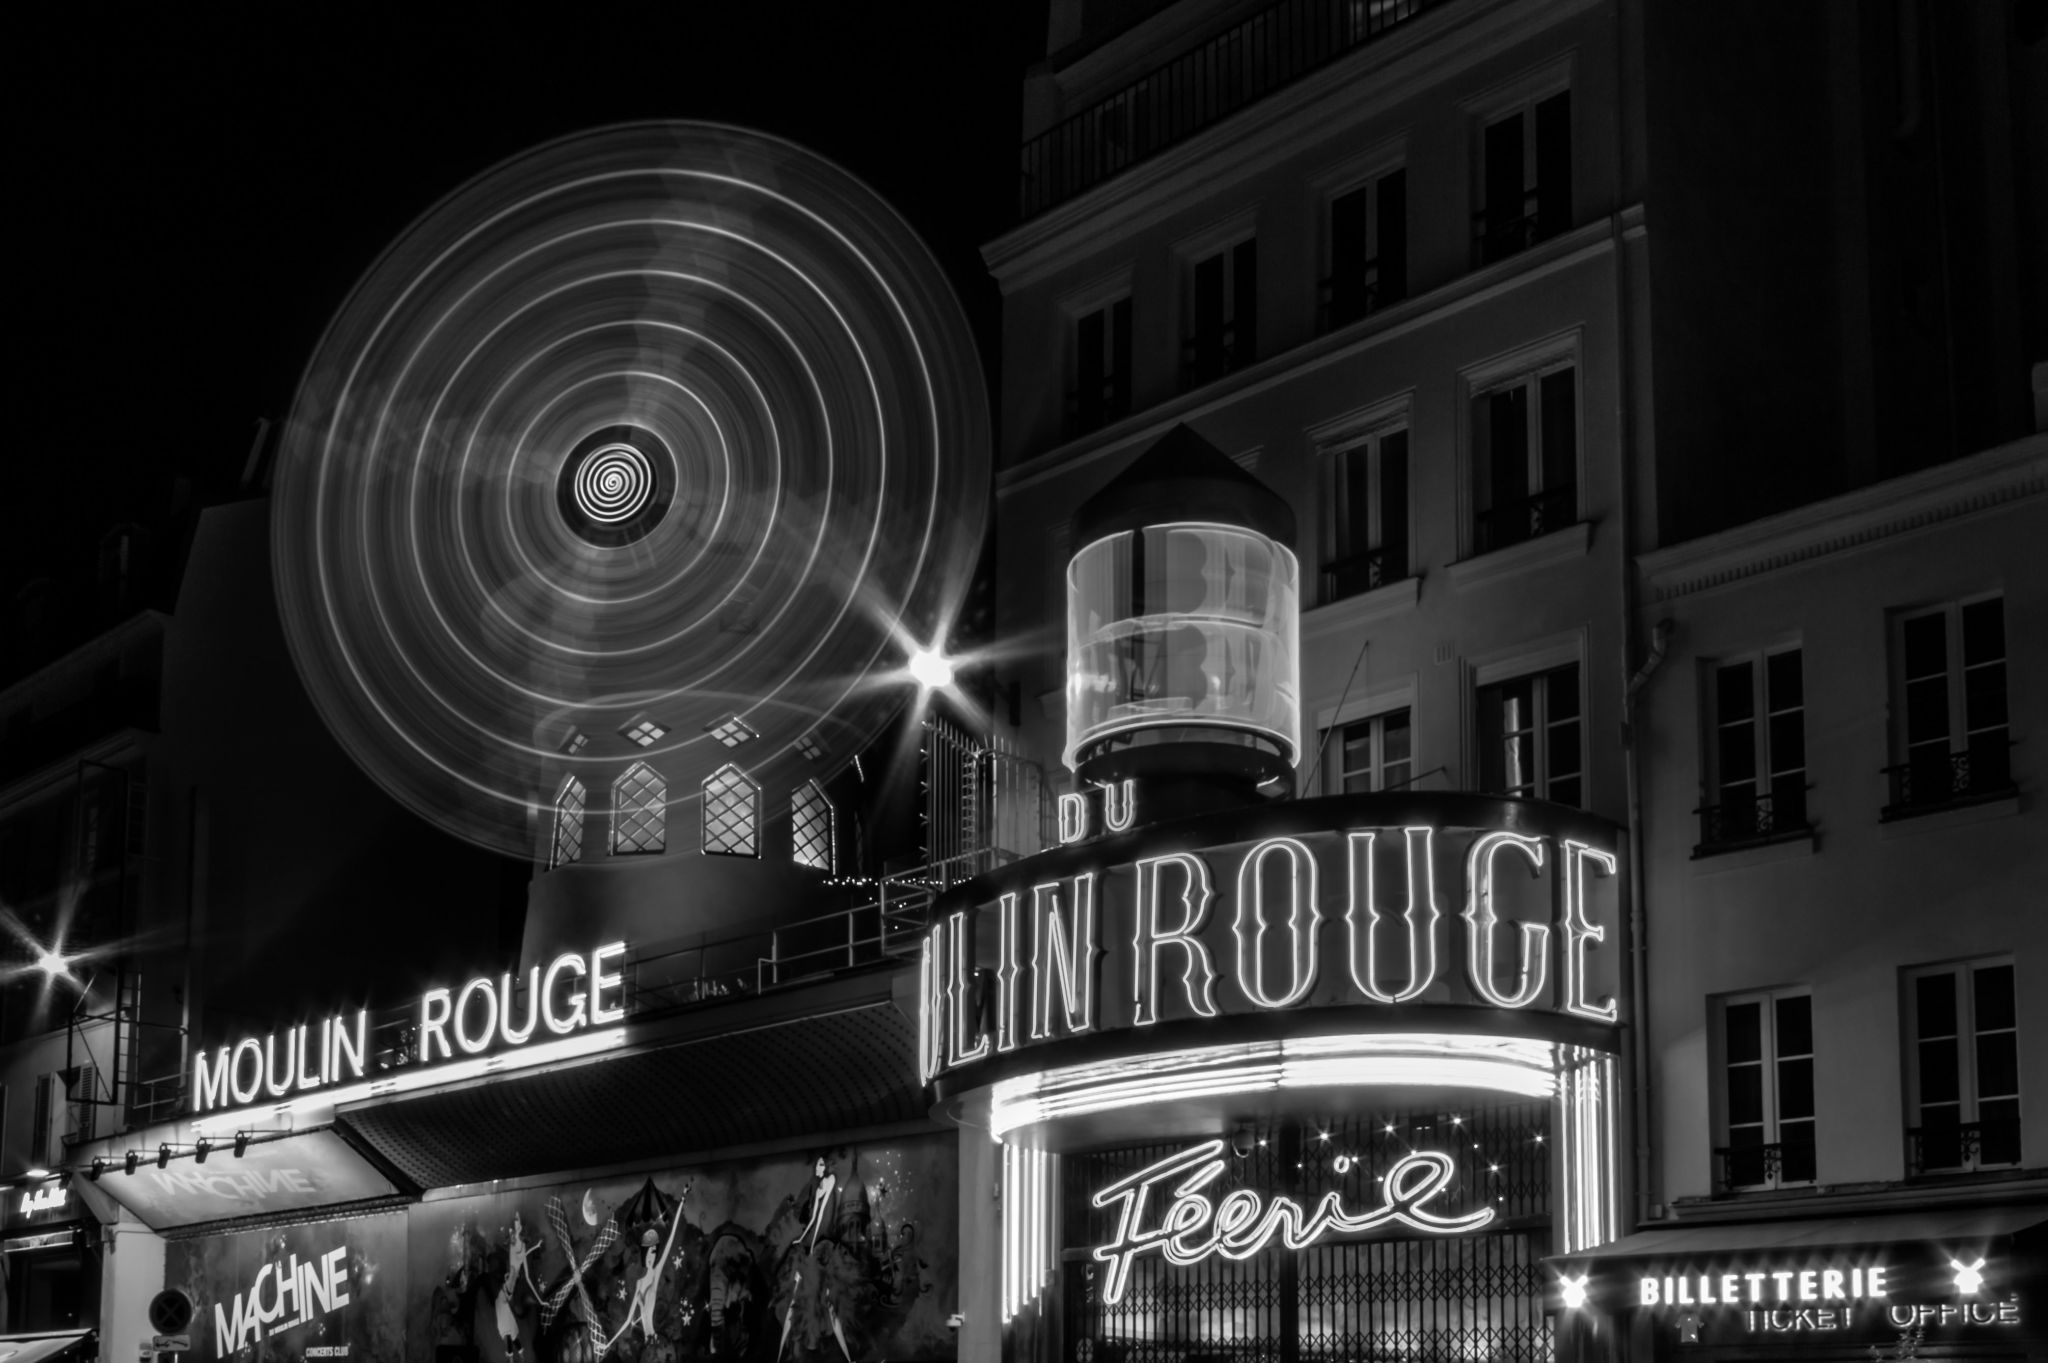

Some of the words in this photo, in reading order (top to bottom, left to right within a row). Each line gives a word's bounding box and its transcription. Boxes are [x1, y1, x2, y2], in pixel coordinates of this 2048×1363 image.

[1058, 779, 1134, 843] DU
[1133, 827, 1618, 1026] ROUGE
[193, 1009, 367, 1111] MOULIN
[418, 940, 627, 1060] ROUGE
[1093, 1140, 1494, 1304] Féerie
[214, 1245, 350, 1360] MACHINE
[1641, 1267, 1888, 1305] BILLETTERIE
[1747, 1307, 1852, 1333] TICKET
[1889, 1302, 2020, 1328] OFFICE
